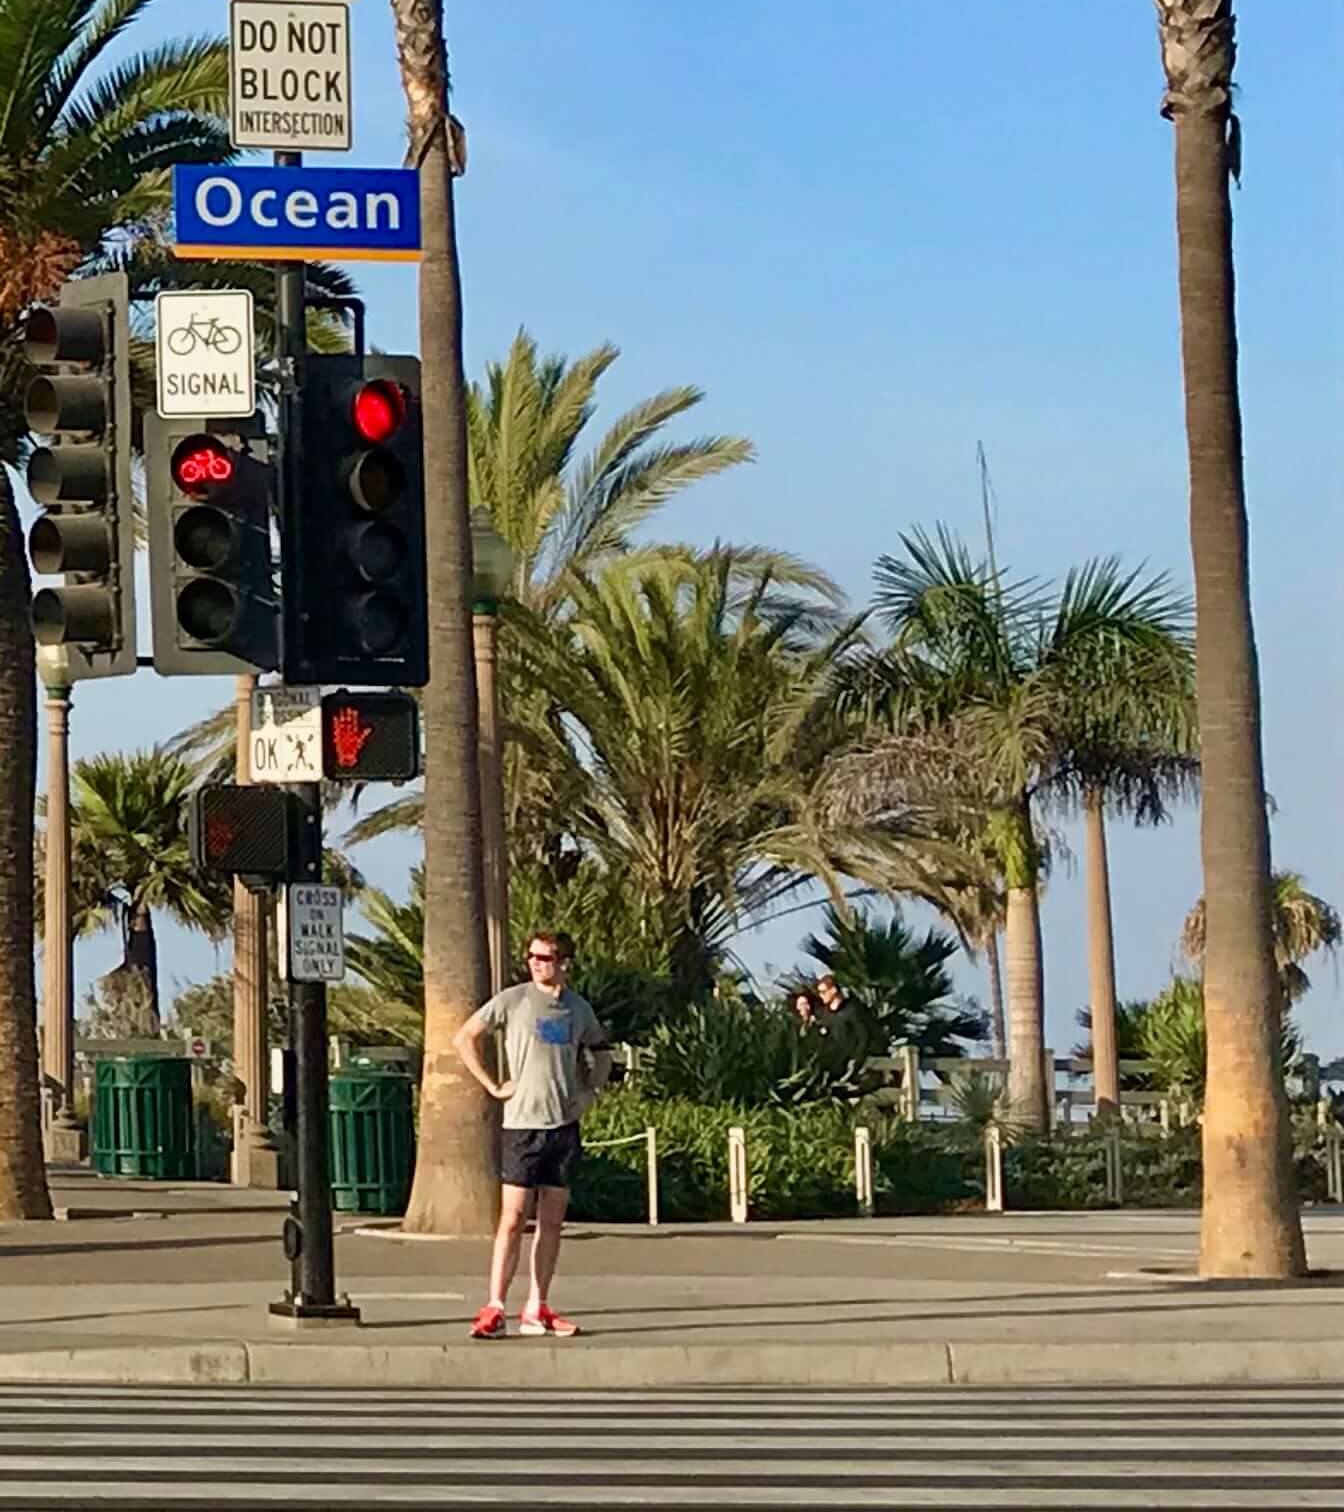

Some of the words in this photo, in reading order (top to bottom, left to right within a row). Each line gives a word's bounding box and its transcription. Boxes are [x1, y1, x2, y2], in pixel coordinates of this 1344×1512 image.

[240, 19, 277, 53] DO
[288, 21, 342, 55] NOT
[240, 69, 343, 103] BLOCK
[240, 110, 344, 138] INTERSECTION
[195, 177, 401, 230] Ocean
[167, 372, 245, 397] SIGNAL
[254, 736, 279, 771] OK
[297, 889, 337, 906] CROSS
[301, 923, 334, 938] WALK
[295, 939, 340, 957] SIGNAL
[303, 957, 335, 974] ONLY
